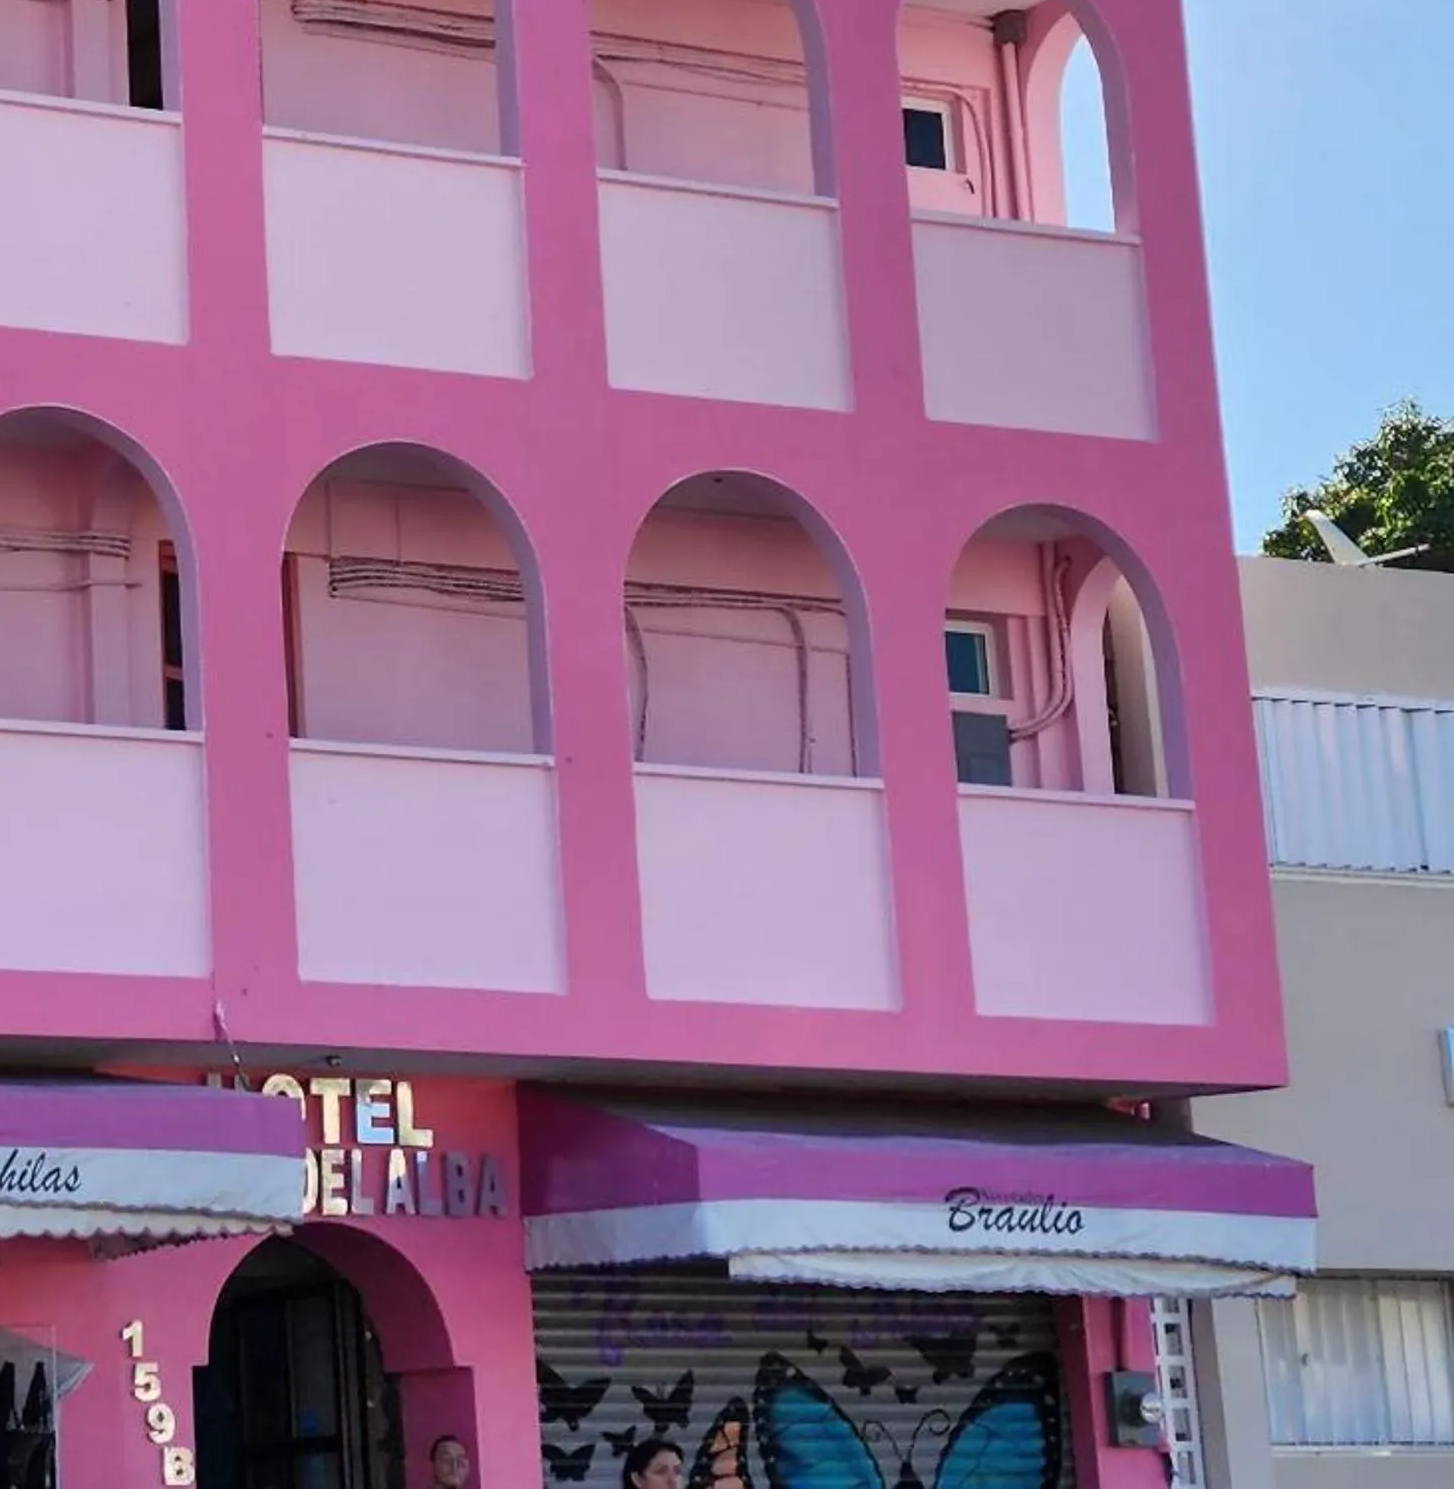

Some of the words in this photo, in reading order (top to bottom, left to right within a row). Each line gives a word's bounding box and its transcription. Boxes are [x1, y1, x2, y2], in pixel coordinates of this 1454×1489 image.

[207, 1072, 434, 1148] TEL
[386, 1147, 508, 1216] ALBA
[944, 1186, 1086, 1234] Braulio
